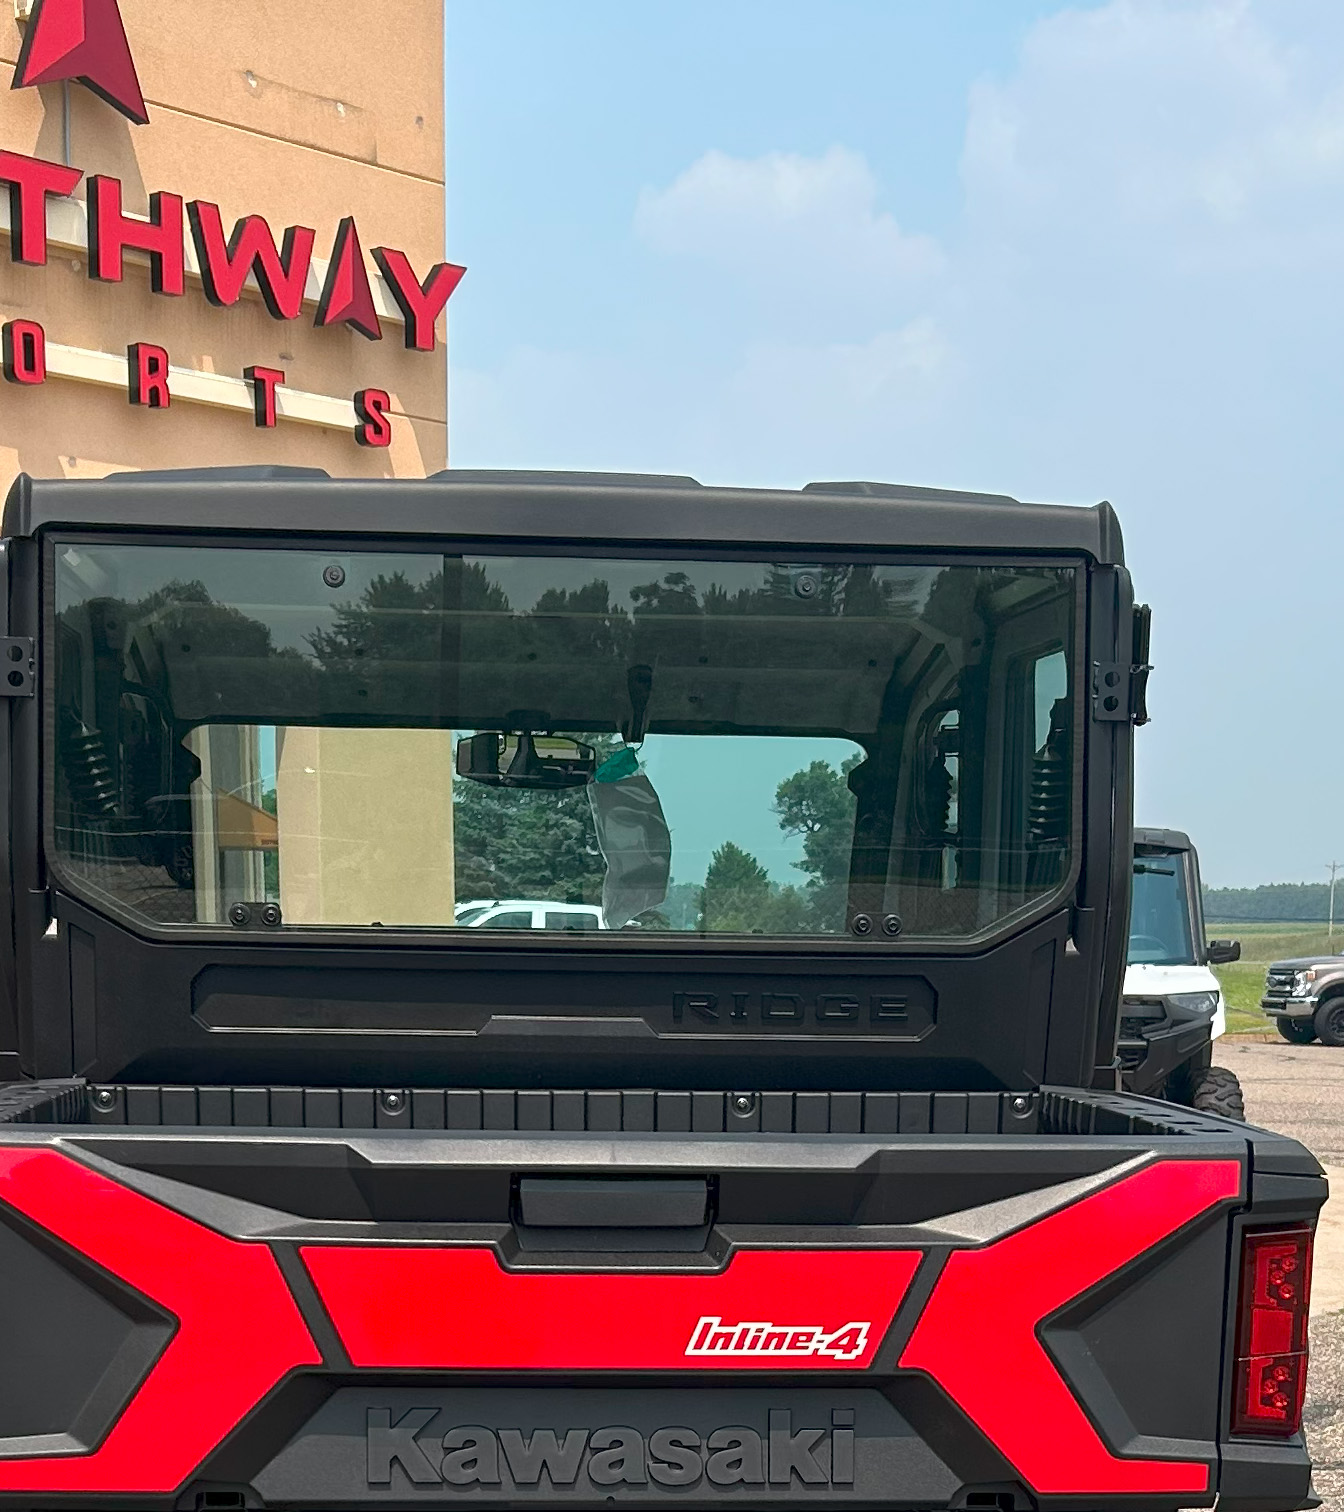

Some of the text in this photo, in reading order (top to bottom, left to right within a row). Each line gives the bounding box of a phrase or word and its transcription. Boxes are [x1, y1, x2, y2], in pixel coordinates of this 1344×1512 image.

[673, 992, 908, 1024] RIDGE
[686, 1316, 871, 1360] Inline-4
[366, 1407, 855, 1486] Kawasaki
